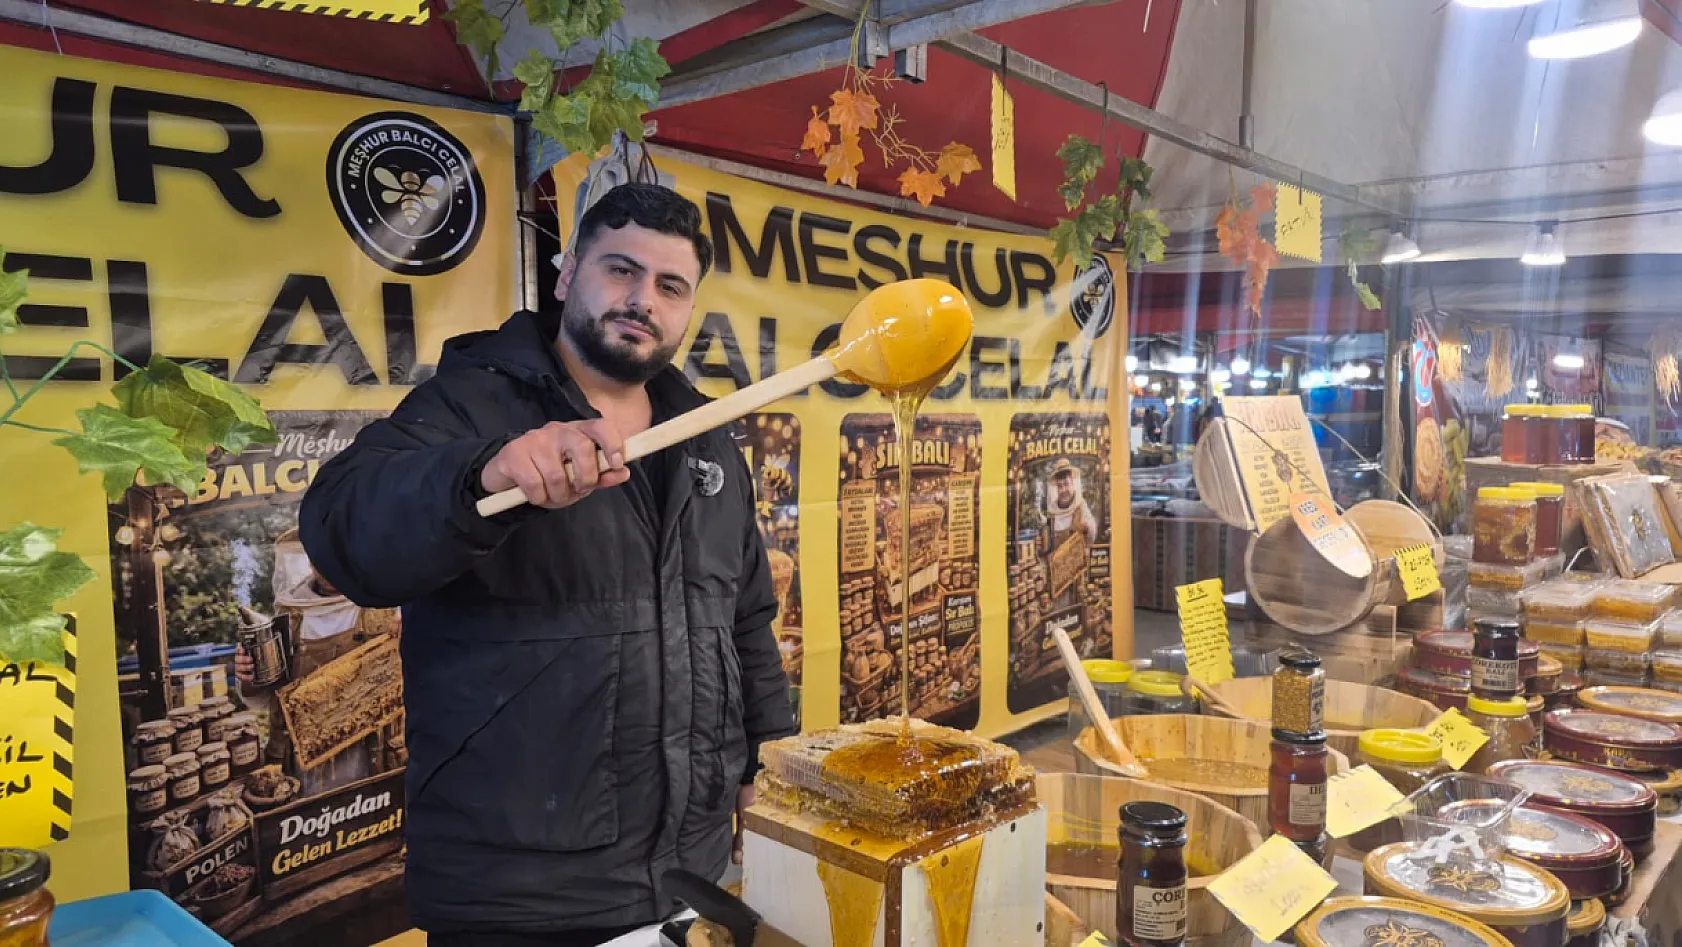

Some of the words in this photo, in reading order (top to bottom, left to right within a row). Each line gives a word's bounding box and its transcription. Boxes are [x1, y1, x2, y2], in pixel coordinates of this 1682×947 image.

[438, 149, 465, 193] CELAL
[272, 839, 332, 876] Gelen
[335, 808, 403, 852] Lezzet!
[280, 791, 391, 845] Doğadan
[185, 836, 249, 885] POLEN
